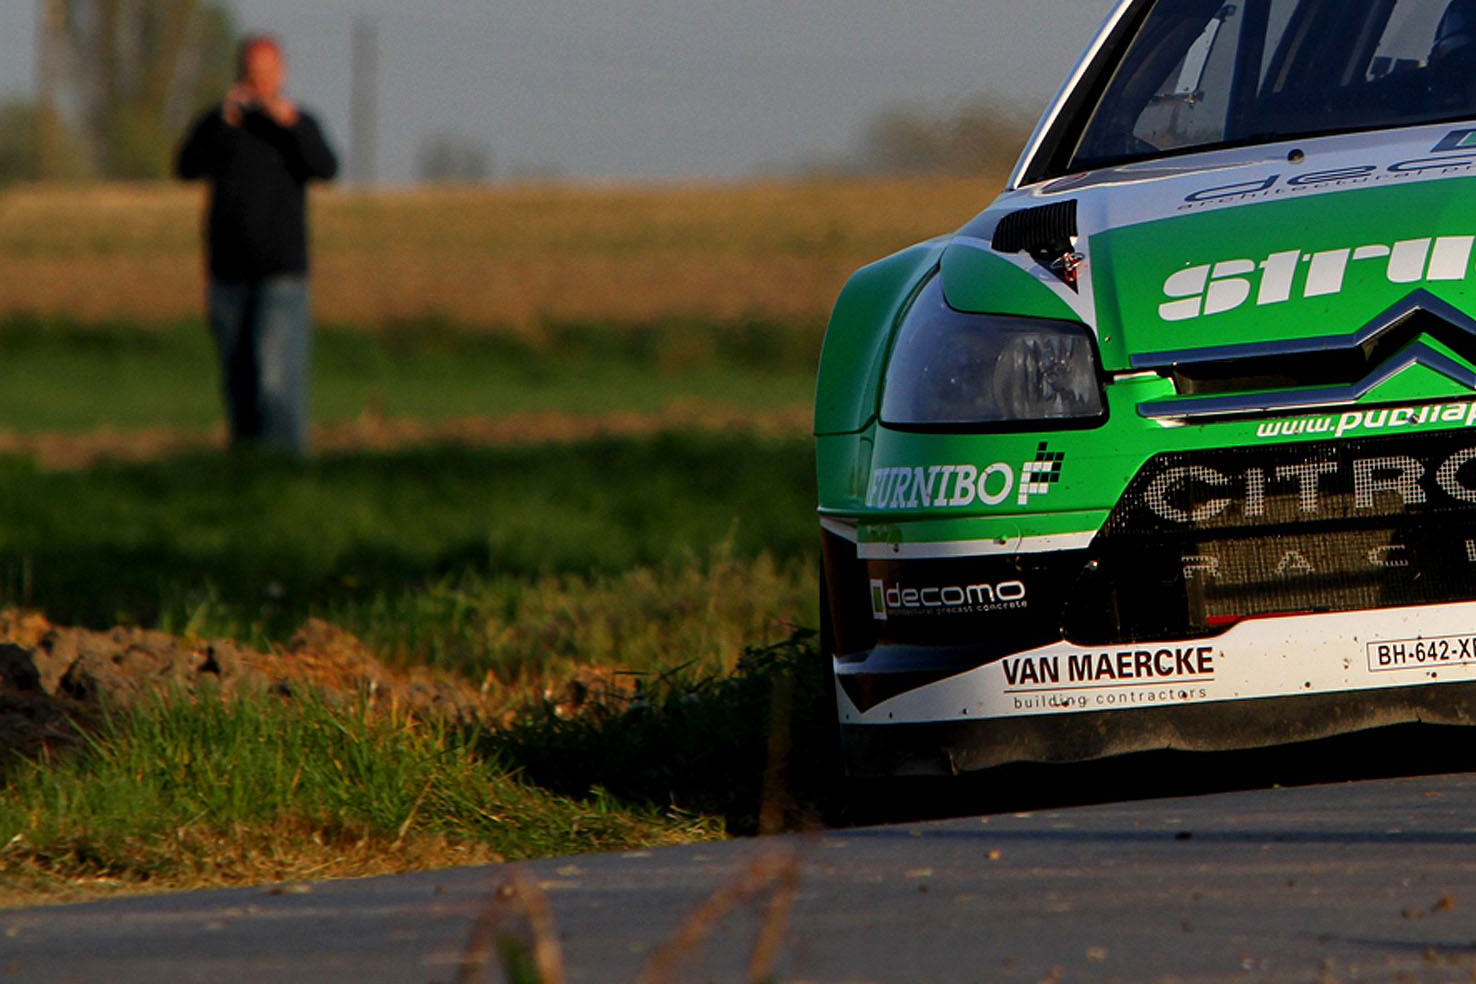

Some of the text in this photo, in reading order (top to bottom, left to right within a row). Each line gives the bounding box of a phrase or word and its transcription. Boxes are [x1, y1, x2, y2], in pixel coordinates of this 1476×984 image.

[865, 462, 1014, 509] FURNIBO
[886, 579, 1026, 608] decomo
[1002, 646, 1215, 686] VAN MAERCKE
[1013, 686, 1208, 710] building contractors
